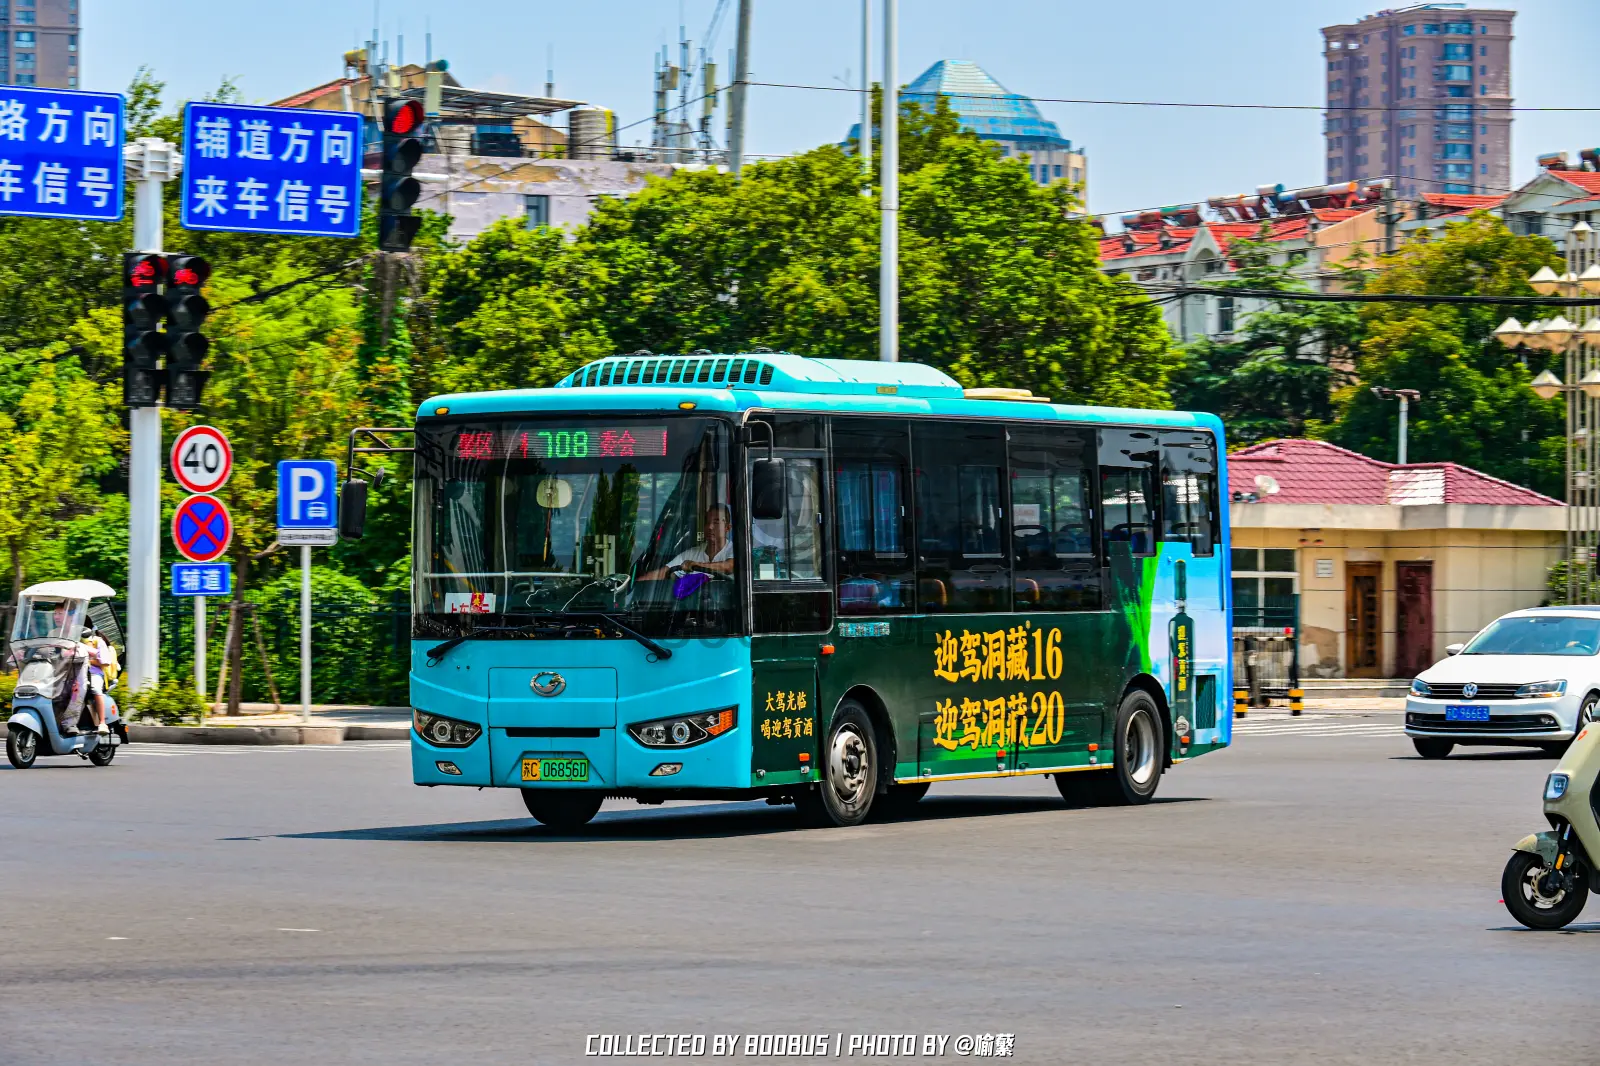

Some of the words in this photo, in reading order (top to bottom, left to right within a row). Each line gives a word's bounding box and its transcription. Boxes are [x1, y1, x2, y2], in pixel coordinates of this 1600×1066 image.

[0, 99, 116, 147] 路方向
[195, 116, 354, 165] 辅道方向
[0, 159, 114, 208] 车信号
[192, 175, 350, 224] 来车信号
[181, 442, 220, 474] 40
[537, 431, 588, 458] 708
[290, 467, 325, 520] P
[933, 626, 1063, 683] 迎驾洞藏16
[765, 690, 807, 712] 大驾光临
[760, 716, 813, 739] 喝迎驾贡酒
